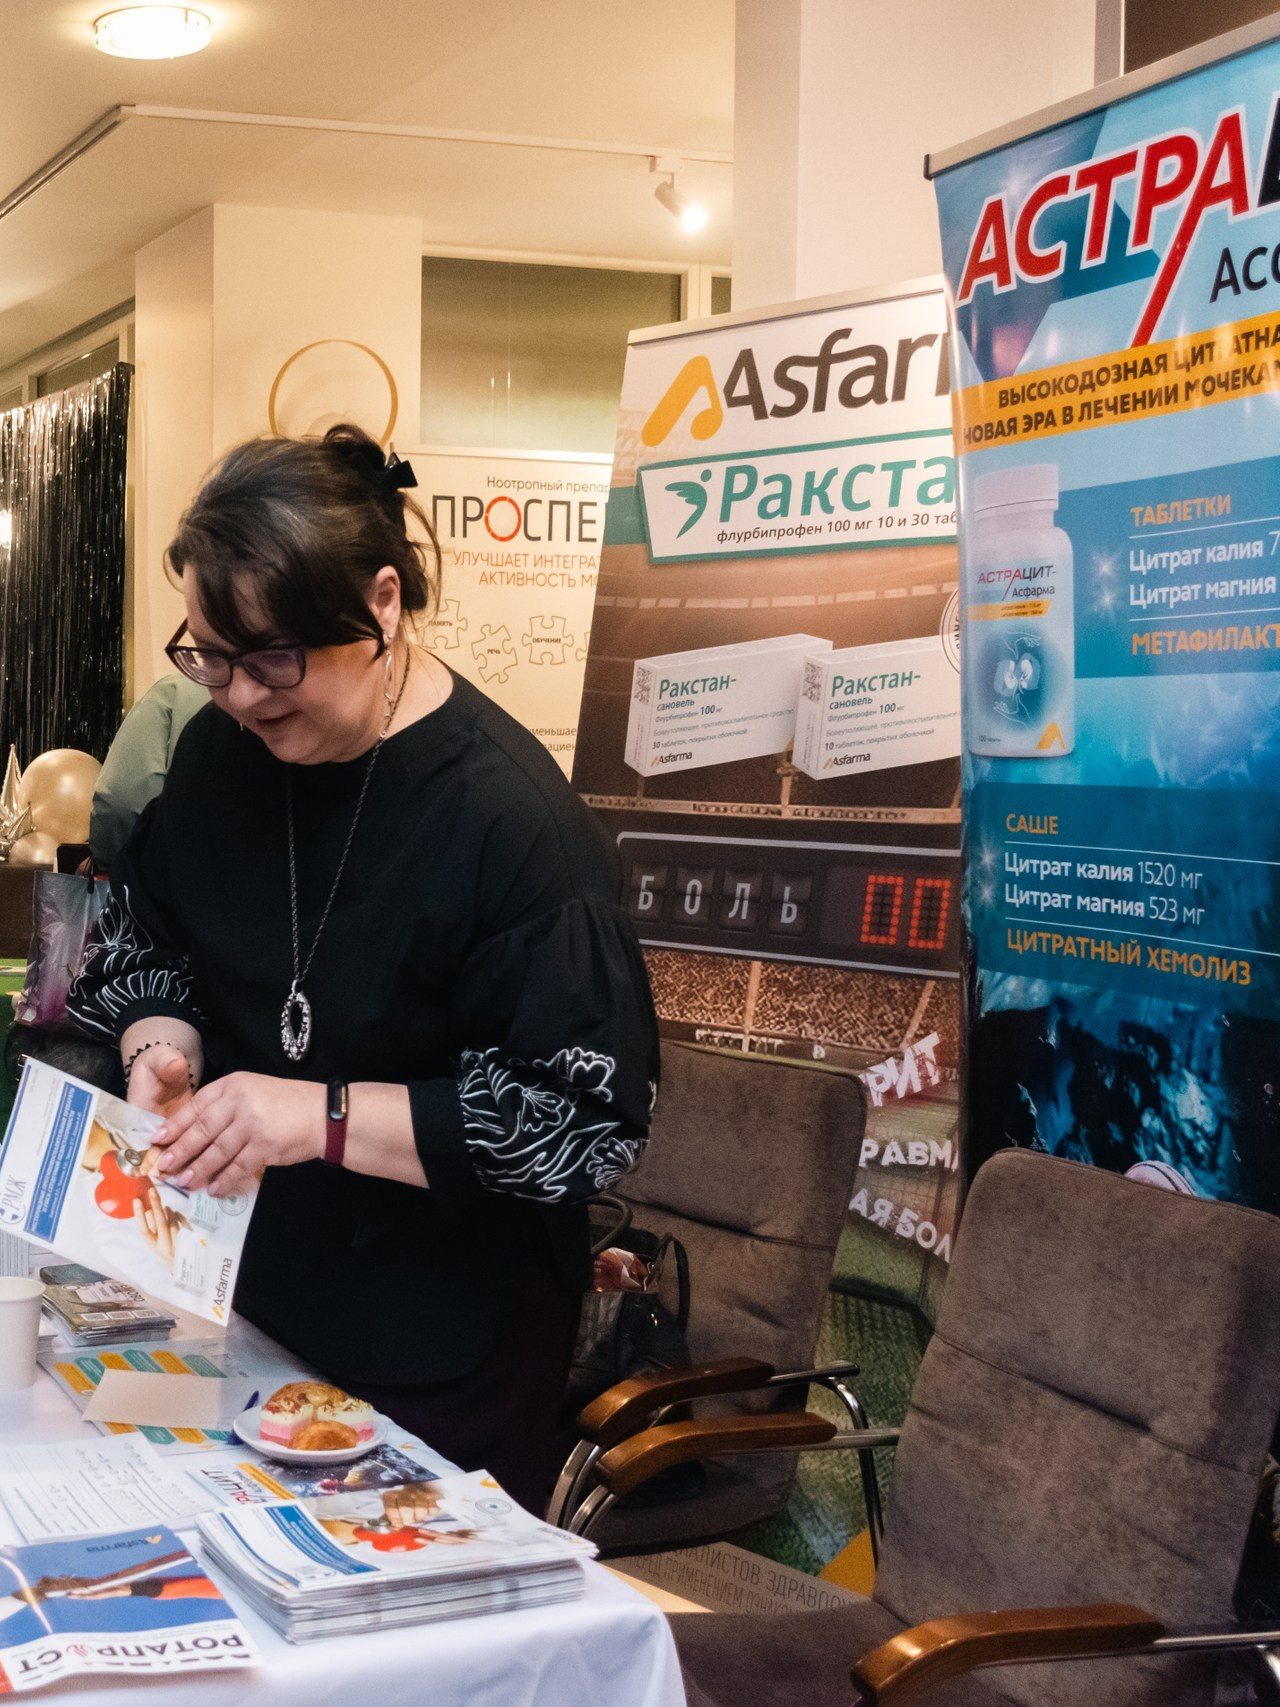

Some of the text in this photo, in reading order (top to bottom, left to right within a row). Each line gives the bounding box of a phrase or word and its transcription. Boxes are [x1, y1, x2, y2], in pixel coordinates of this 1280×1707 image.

[723, 328, 950, 421] Asfar
[999, 353, 1168, 408] ВЫСОКОДОЗНАЯ
[964, 417, 1017, 445] НОВАЯ
[1022, 410, 1056, 433] ЭРА
[1062, 406, 1073, 426] В
[1078, 382, 1179, 422] ЛЕЧЕНИИ
[486, 476, 563, 492] Ноотропный
[432, 495, 597, 542] ПРОСПЕ
[1130, 495, 1231, 527] ТАБЛЕТКИ
[717, 522, 823, 544] флурбипрофен
[827, 520, 851, 534] 100
[854, 519, 872, 534] мг
[877, 516, 894, 529] 10
[911, 513, 929, 526] 30
[454, 551, 530, 568] УЛУЧШАЕТ
[1129, 547, 1201, 575] Цитрат
[1206, 540, 1263, 567] калия
[478, 571, 576, 588] АКТИВНОСТЬ
[1012, 586, 1055, 599] Асфарма
[1129, 576, 1276, 609] Цитрат магния
[659, 675, 737, 699] Ракстан-
[831, 671, 921, 697] Ракстан-
[657, 699, 695, 711] сановель
[700, 705, 716, 715] 100
[829, 697, 873, 710] сановель
[880, 702, 896, 714] 100
[652, 741, 661, 749] 30
[659, 751, 693, 764] Asfarma
[825, 742, 834, 751] 10
[833, 753, 871, 766] Asfarma
[1005, 813, 1058, 834] САШЕ
[1004, 853, 1203, 889] Цитрат калия 1520 мг
[1004, 884, 1205, 925] Цитрат магния 523 мг
[1007, 928, 1251, 986] ЦИТРАТНЫЙ ХЕМОЛИЗ
[861, 1032, 940, 1106] РИТ
[214, 1257, 233, 1306] Asfarma
